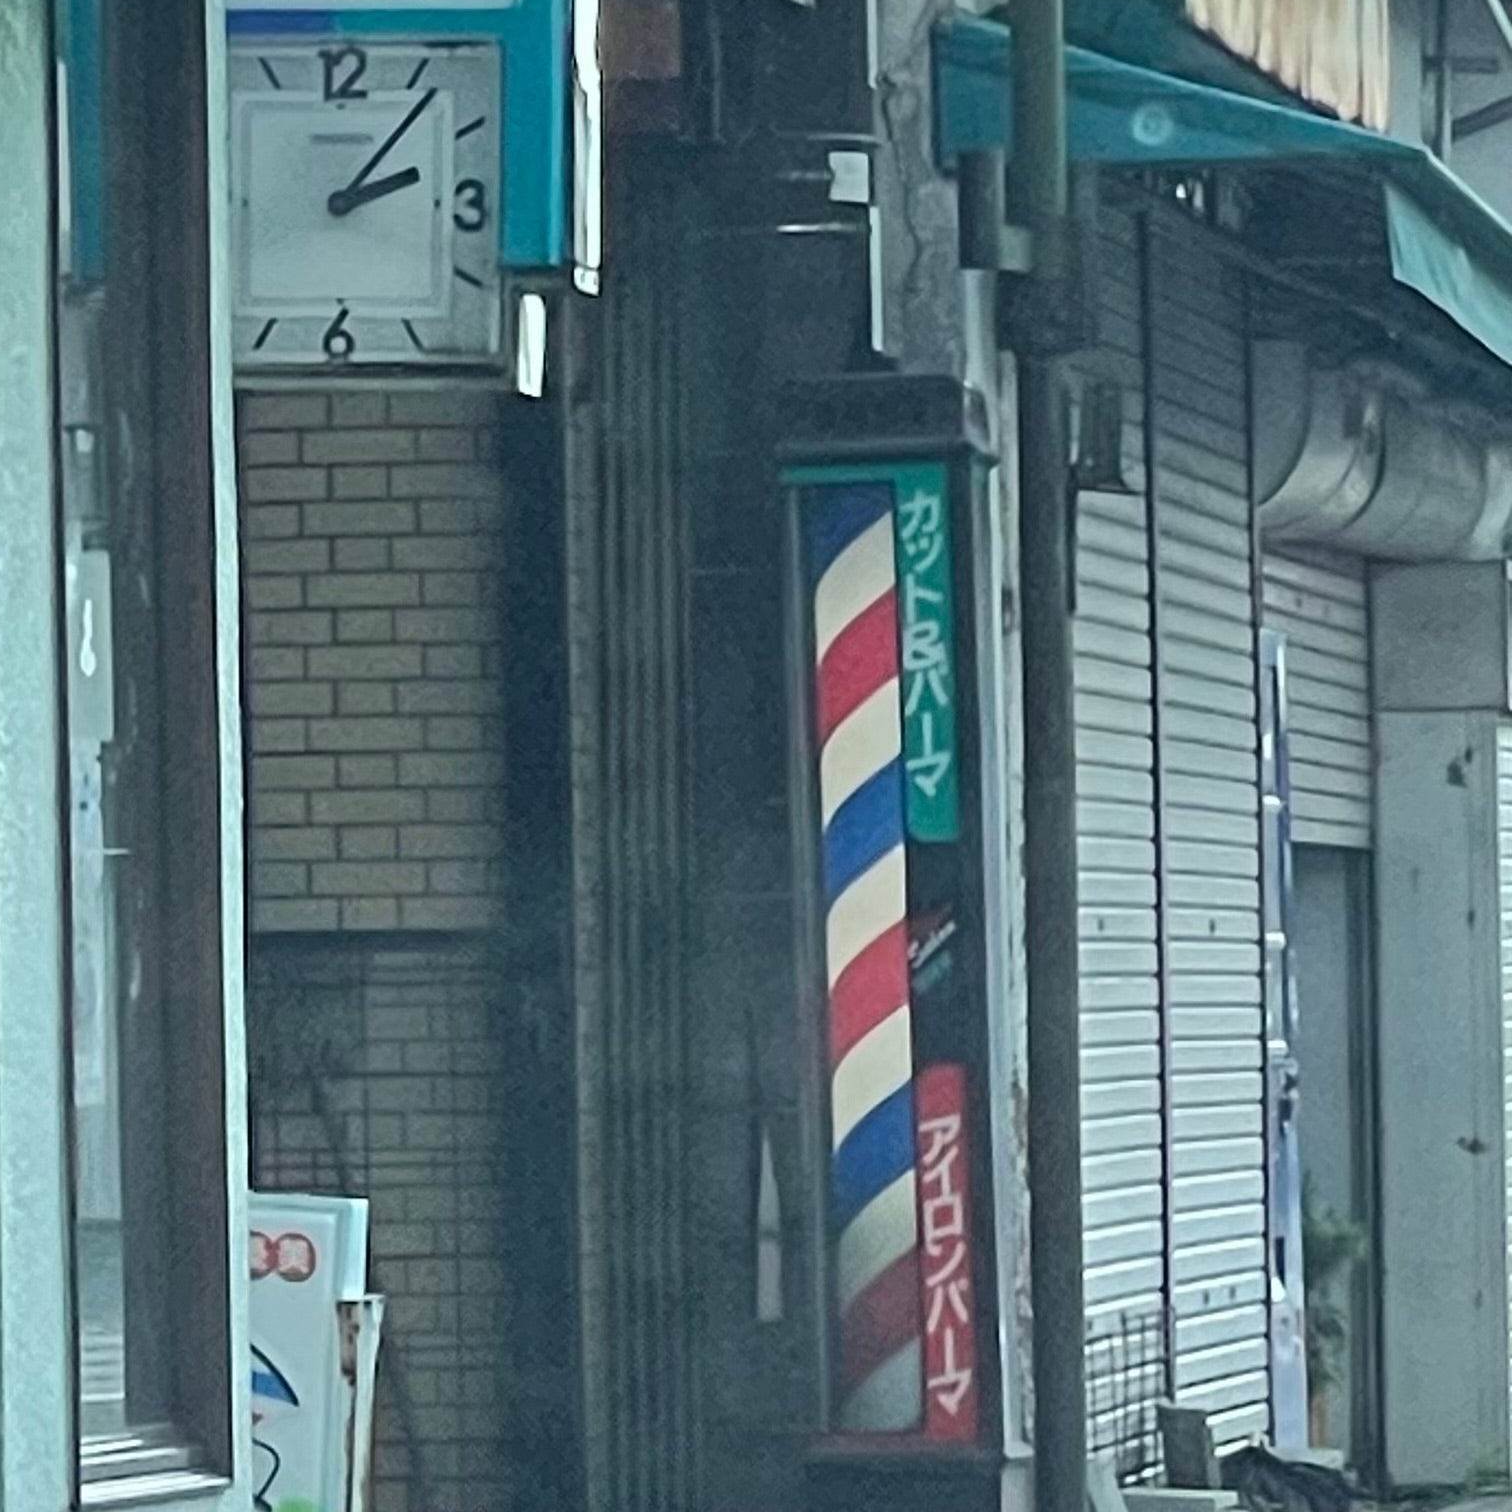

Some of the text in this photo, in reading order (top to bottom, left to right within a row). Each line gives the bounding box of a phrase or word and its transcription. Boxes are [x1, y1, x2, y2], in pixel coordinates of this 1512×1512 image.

[317, 45, 368, 102] 12
[453, 178, 487, 232] 3
[322, 308, 355, 360] 6
[918, 1112, 973, 1415] アイロンパーマ
